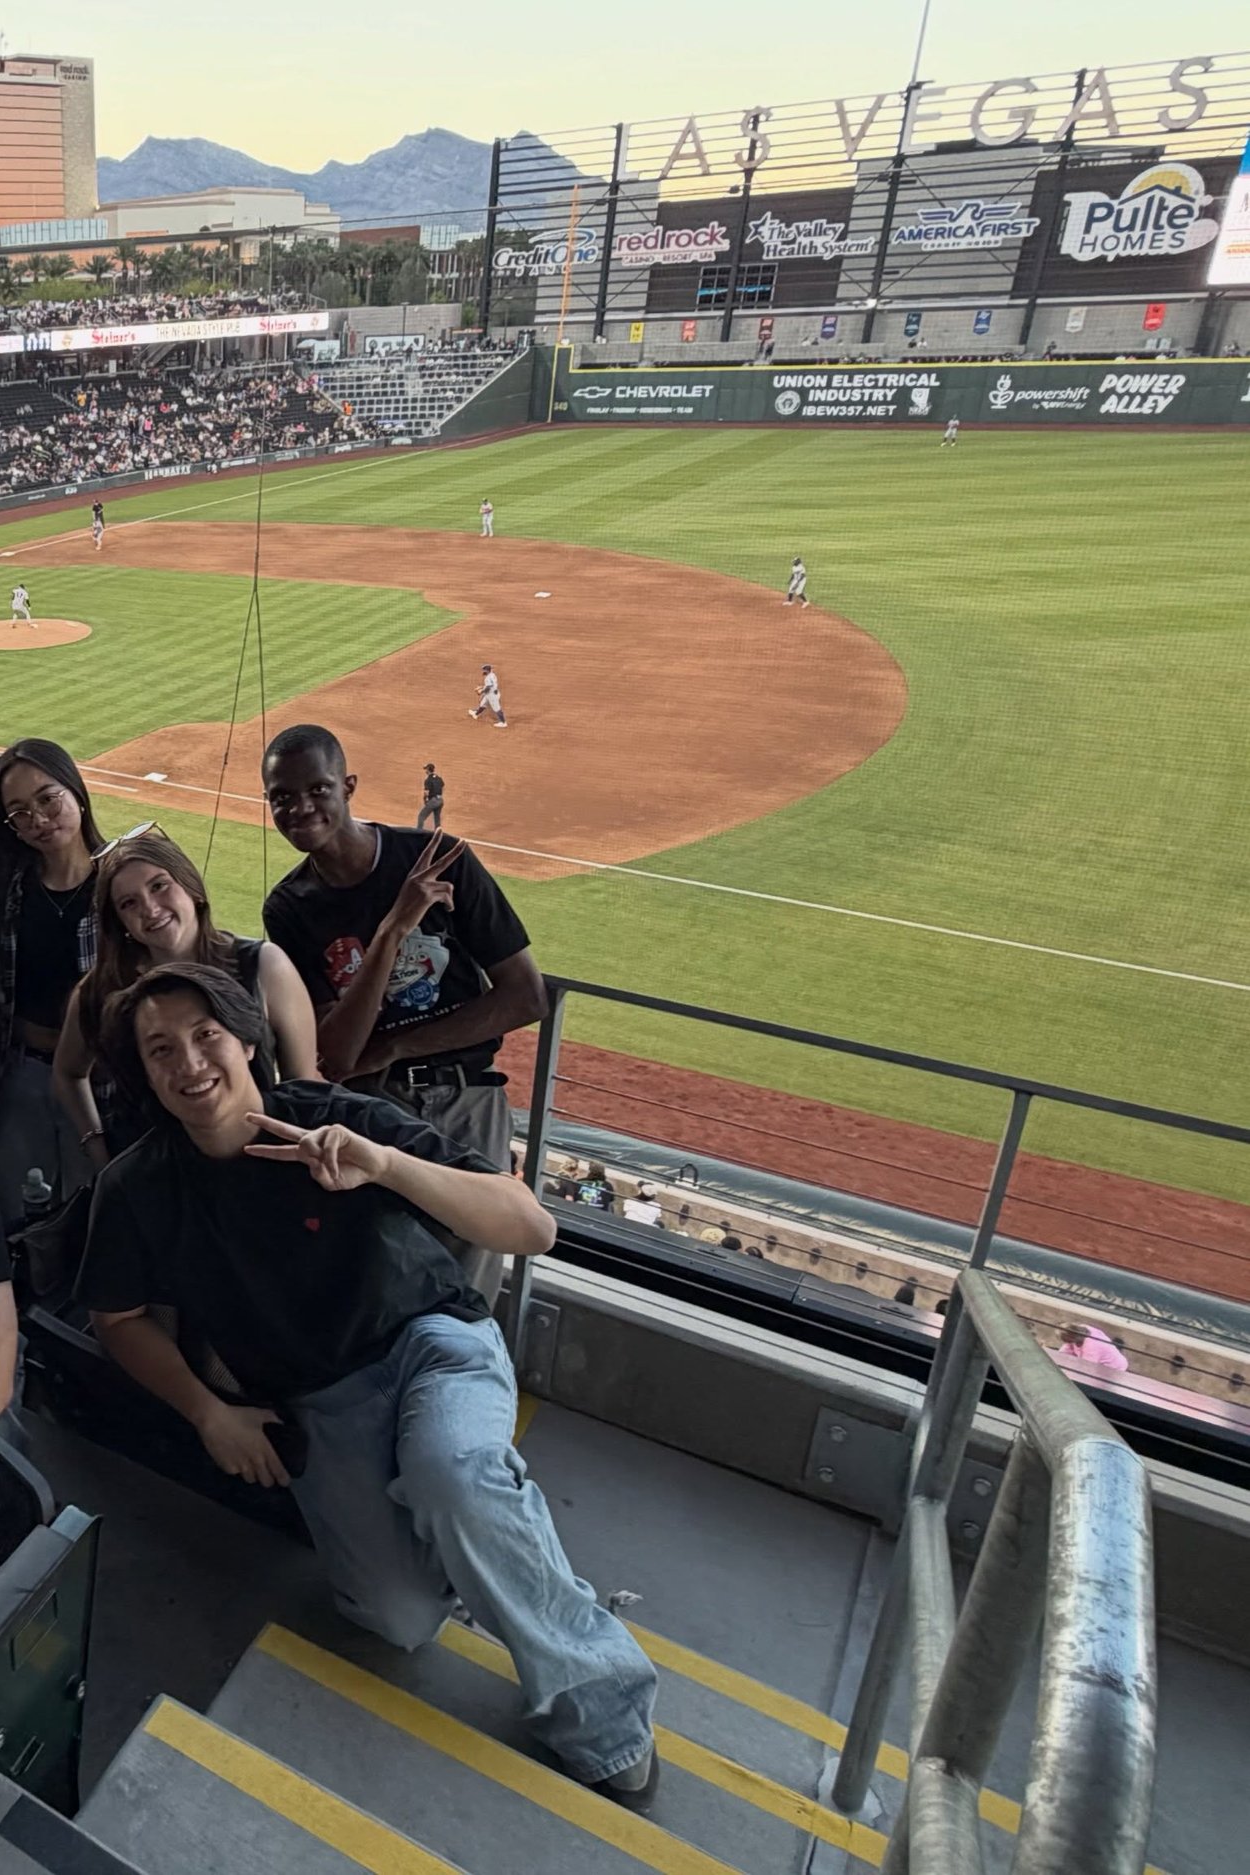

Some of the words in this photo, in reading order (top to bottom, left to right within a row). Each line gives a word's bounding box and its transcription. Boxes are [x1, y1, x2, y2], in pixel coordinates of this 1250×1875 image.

[617, 105, 774, 182] LAS
[835, 56, 1215, 160] VEGAS
[1083, 194, 1195, 236] Pulte
[616, 227, 661, 252] red
[663, 222, 725, 248] rock
[767, 225, 796, 241] The
[793, 220, 844, 244] Valley
[895, 225, 975, 243] AMERICA
[977, 219, 1038, 238] FIRST
[1079, 230, 1187, 254] HOMES
[764, 243, 819, 259] Health
[820, 237, 872, 260] System
[614, 385, 715, 398] CHEVROLET
[772, 374, 828, 388] UNION
[831, 373, 941, 388] ELECTRICAL
[1098, 373, 1187, 394] POWER
[807, 388, 898, 402] INDUSTRY
[1014, 386, 1091, 403] powershift
[1098, 394, 1176, 414] ALLEY
[801, 404, 898, 416] IBEW357.NET
